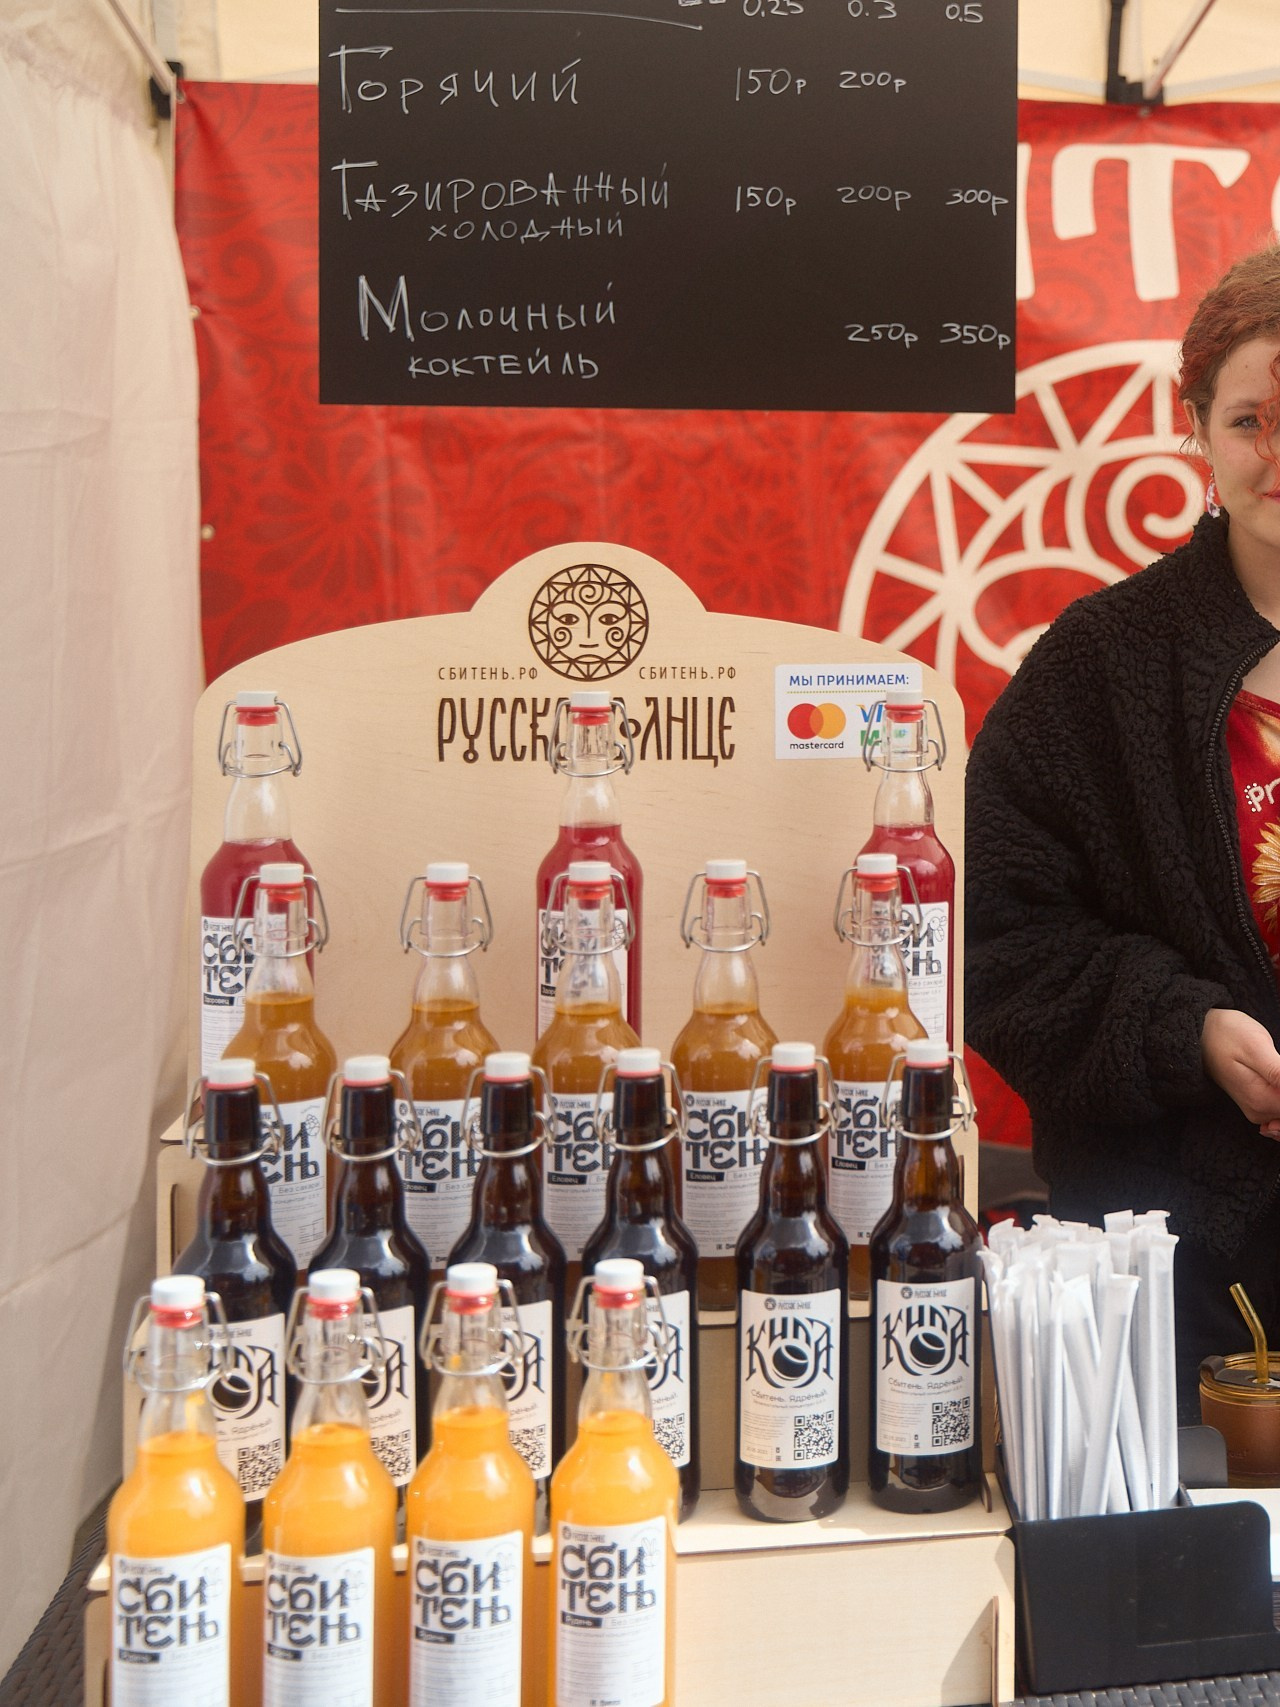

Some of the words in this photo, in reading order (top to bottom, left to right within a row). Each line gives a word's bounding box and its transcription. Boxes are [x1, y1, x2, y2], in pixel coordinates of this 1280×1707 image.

[848, 0, 897, 19] 0.3
[945, 3, 984, 23] 0.5
[328, 45, 581, 114] Горячий
[358, 274, 616, 342] Молочный
[438, 667, 538, 680] СБИТЕНЬ.РФ
[639, 666, 737, 680] СБИТЕНЬ.РФ
[789, 675, 812, 686] МЫ
[817, 674, 909, 686] ПРИНИМАЕМ:
[789, 741, 844, 750] mastercard
